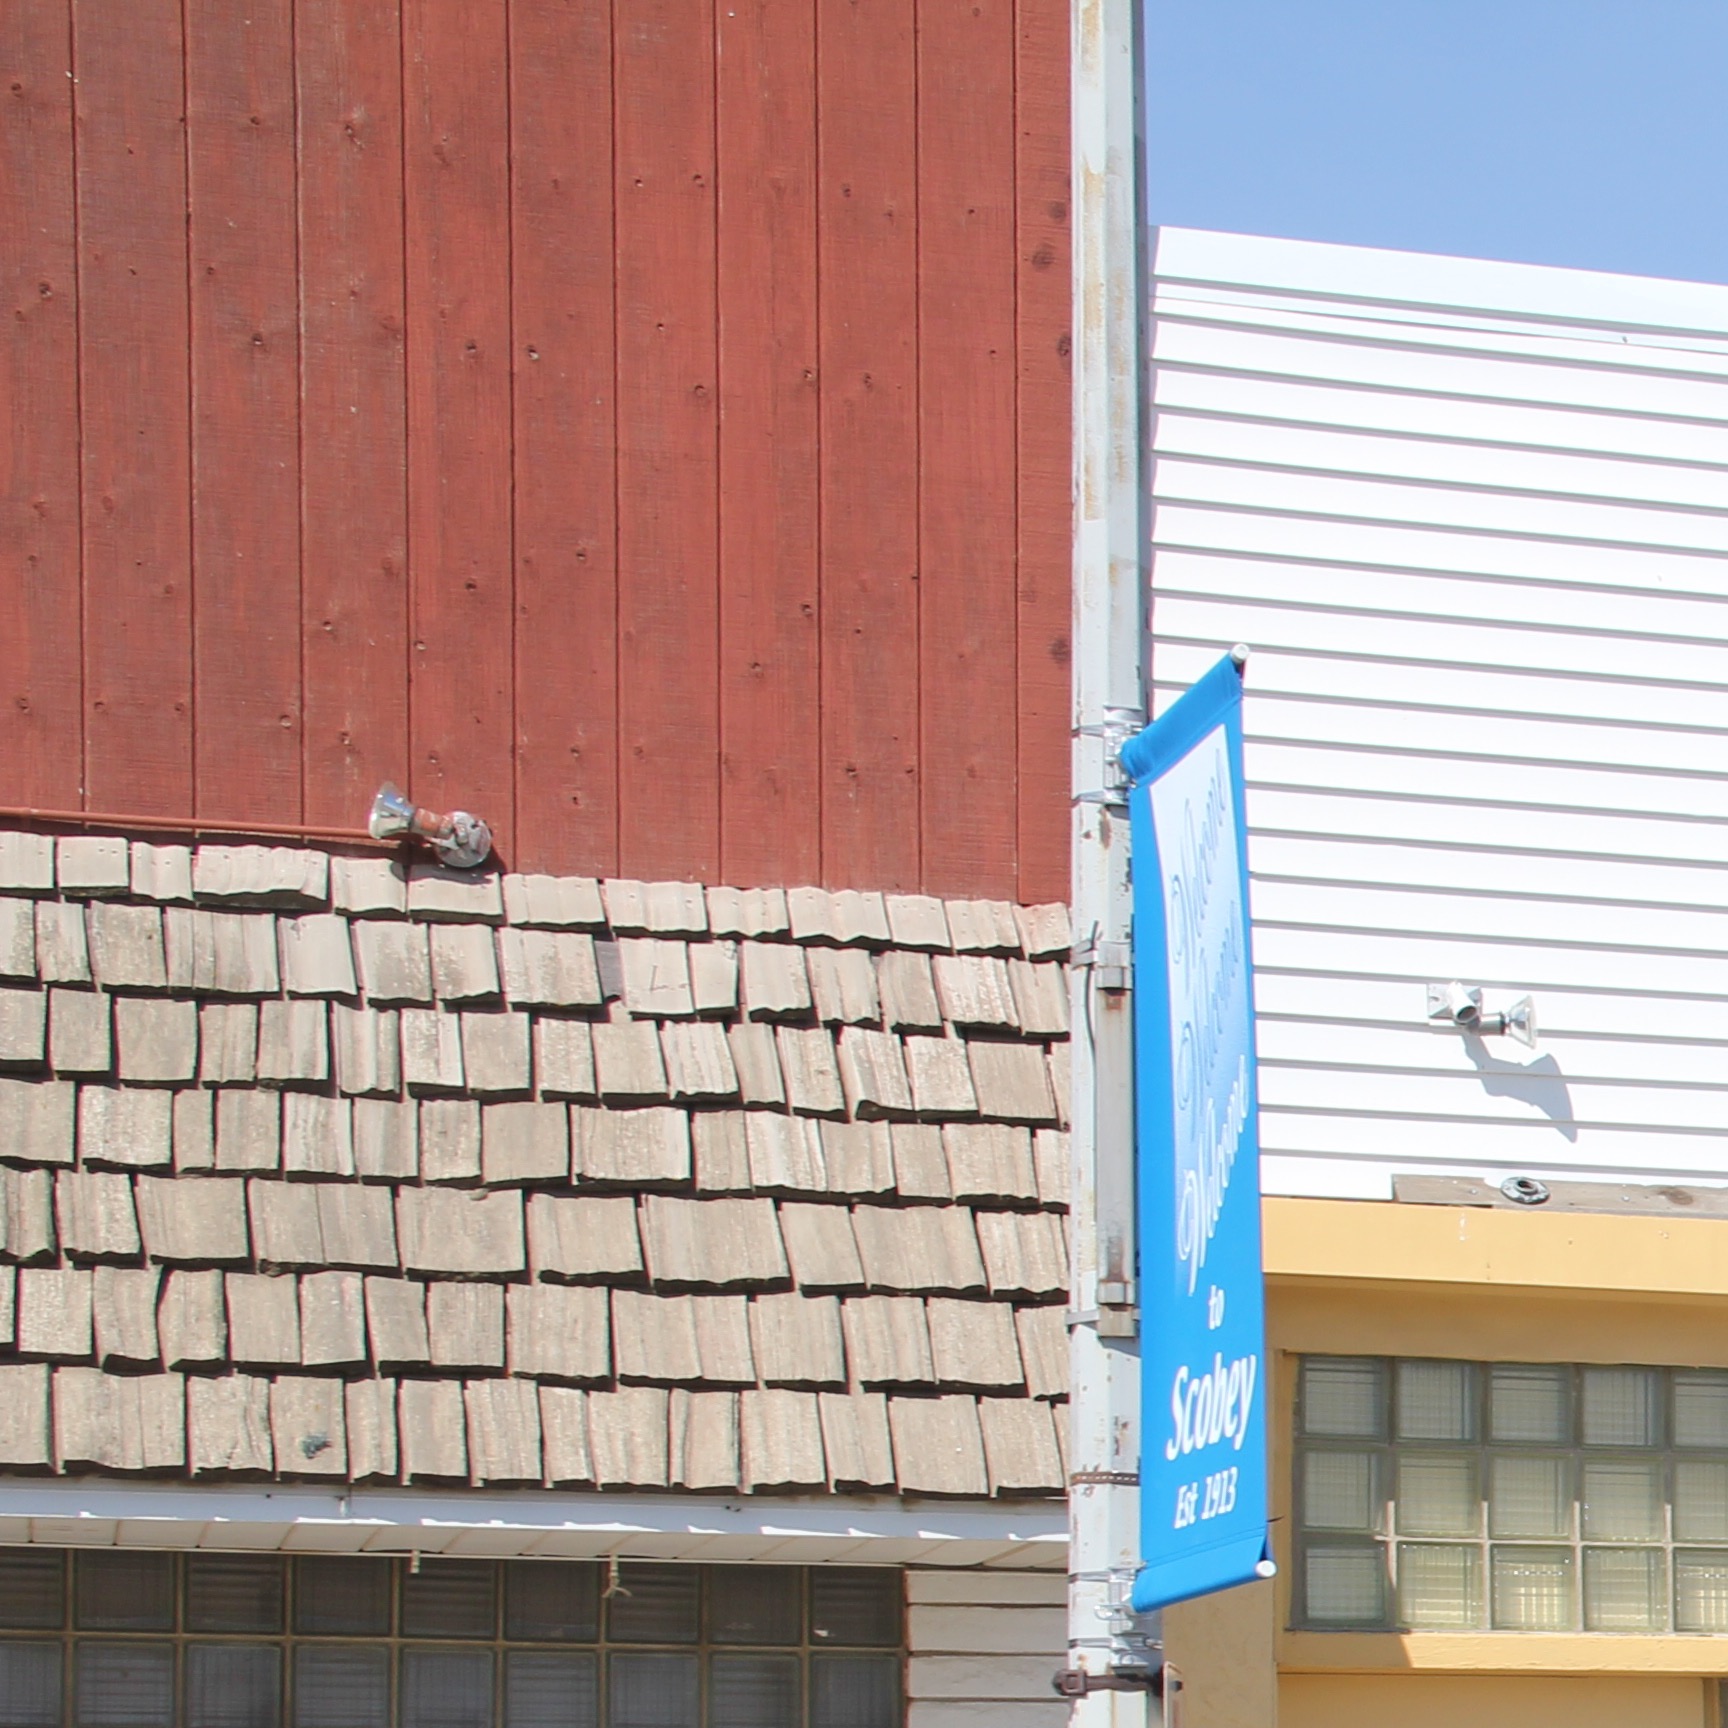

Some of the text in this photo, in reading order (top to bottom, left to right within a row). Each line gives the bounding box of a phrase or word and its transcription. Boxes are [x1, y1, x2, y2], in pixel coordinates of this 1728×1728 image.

[1177, 1053, 1250, 1297] Welcome
[1208, 1284, 1225, 1330] to
[1166, 1351, 1257, 1461] Scobey
[1174, 1465, 1239, 1529] Est 1913
